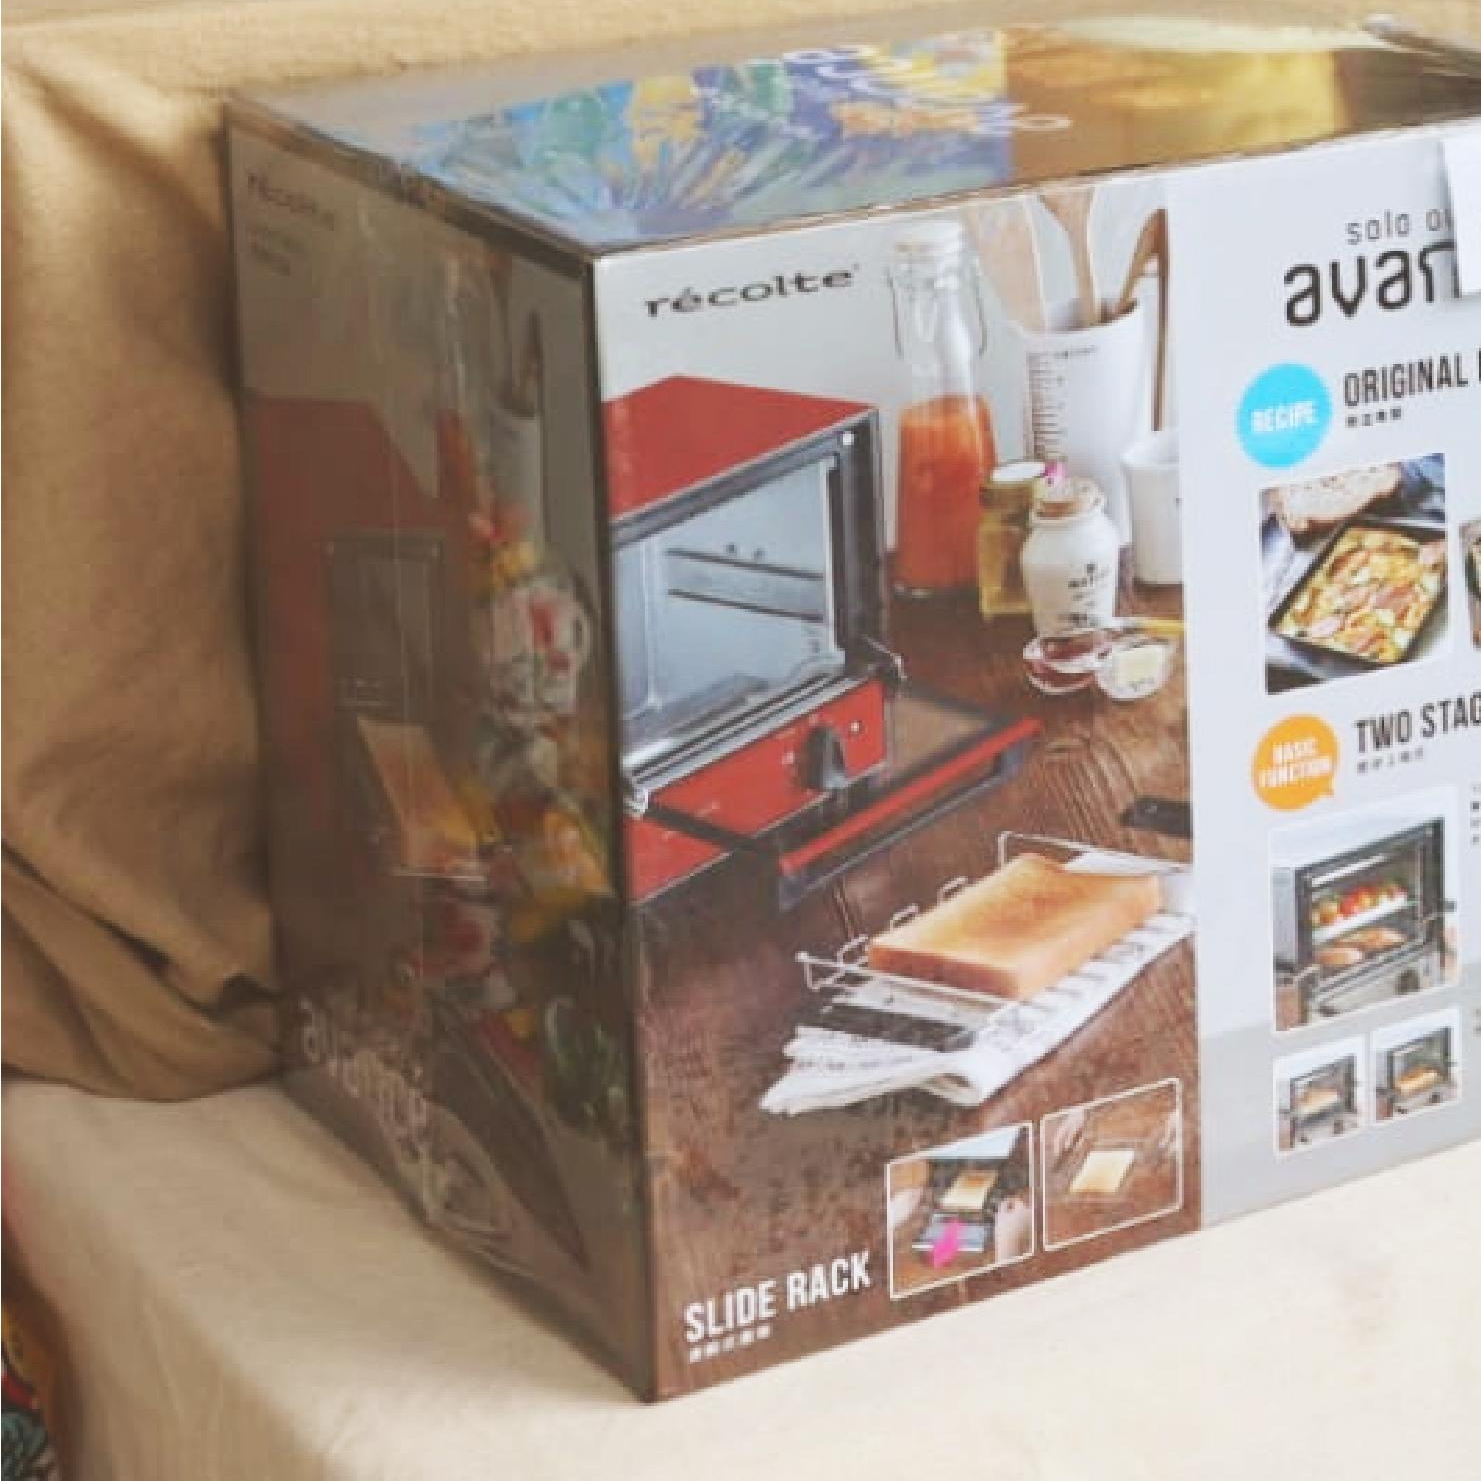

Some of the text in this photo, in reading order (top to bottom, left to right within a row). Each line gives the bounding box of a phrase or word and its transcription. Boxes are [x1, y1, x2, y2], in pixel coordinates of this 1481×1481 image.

[1344, 209, 1410, 245] solo
[646, 261, 855, 318] récolte
[1283, 237, 1462, 328] avan
[1344, 352, 1469, 408] ORIGINAL
[1250, 400, 1319, 432] RECIPE
[1354, 709, 1413, 754] TWO
[684, 1279, 777, 1343] SLIDE
[786, 1249, 872, 1312] RACK
